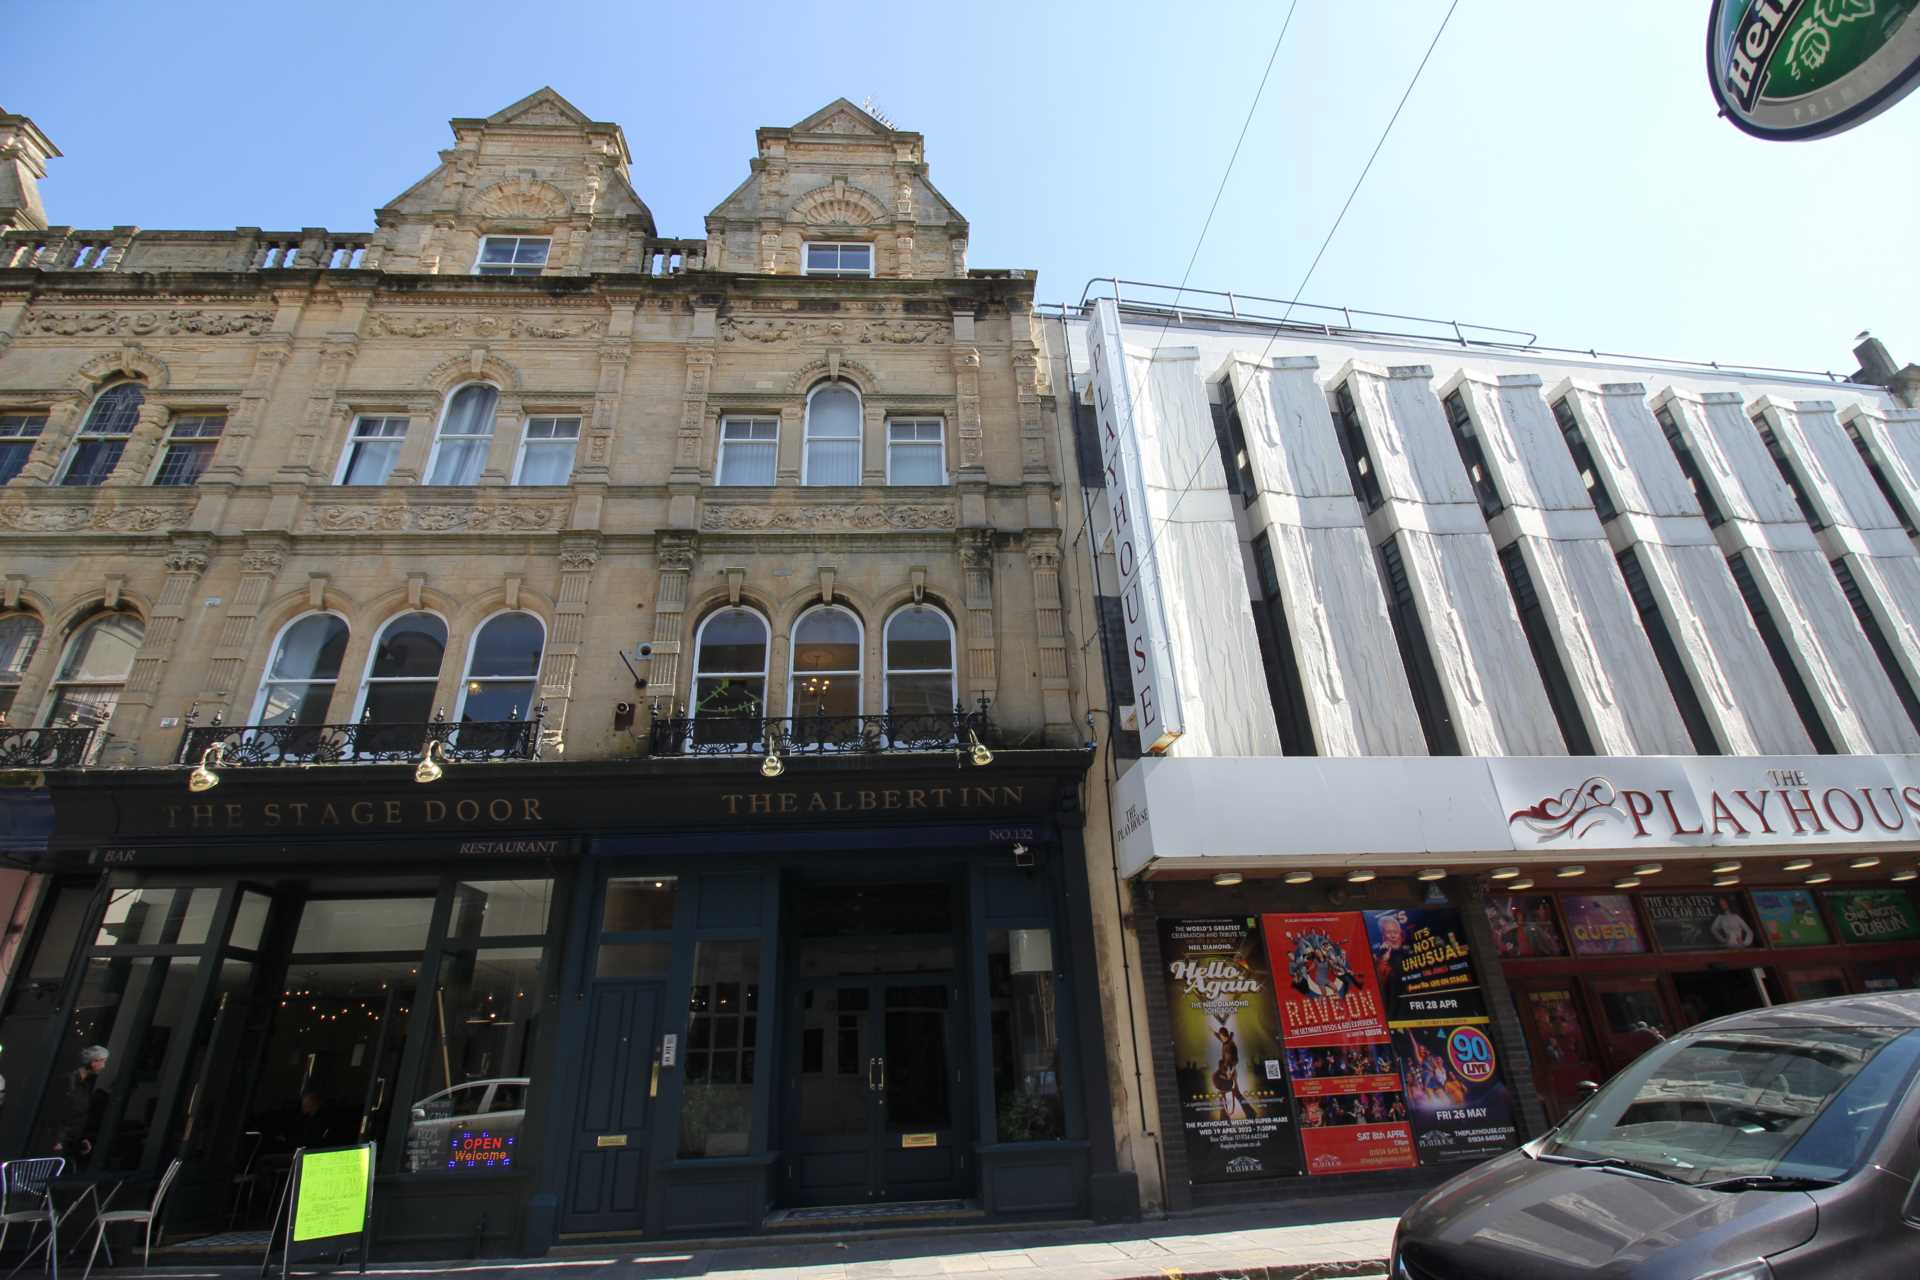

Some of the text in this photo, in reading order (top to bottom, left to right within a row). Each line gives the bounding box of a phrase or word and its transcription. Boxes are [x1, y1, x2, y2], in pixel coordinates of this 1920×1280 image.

[1729, 0, 1791, 98] Hei
[1093, 344, 1156, 729] PLAYHOUSE
[1768, 768, 1809, 787] THE
[721, 785, 1025, 814] THE ALBERT INN
[162, 798, 543, 829] THE STAGE DOOR
[104, 850, 137, 863] BAR
[460, 840, 559, 855] RESTAURANT
[1413, 927, 1431, 941] IT'S
[1573, 922, 1638, 942] QUEEN
[1850, 912, 1910, 937] DUBLIN
[1413, 936, 1436, 953] NOT
[1401, 942, 1469, 972] UNUSUAL
[1184, 977, 1263, 999] Again
[1285, 989, 1377, 1027] RAVE ON
[1409, 999, 1458, 1010] FRI 28 APR
[1453, 1033, 1489, 1062] 90
[1466, 1063, 1488, 1075] LIVE
[1436, 1107, 1488, 1120] FRI 26 MAY
[463, 1137, 503, 1151] OPEN
[1356, 1132, 1371, 1141] SAT
[1386, 1129, 1408, 1139] APRIL
[455, 1149, 508, 1161] Welcome
